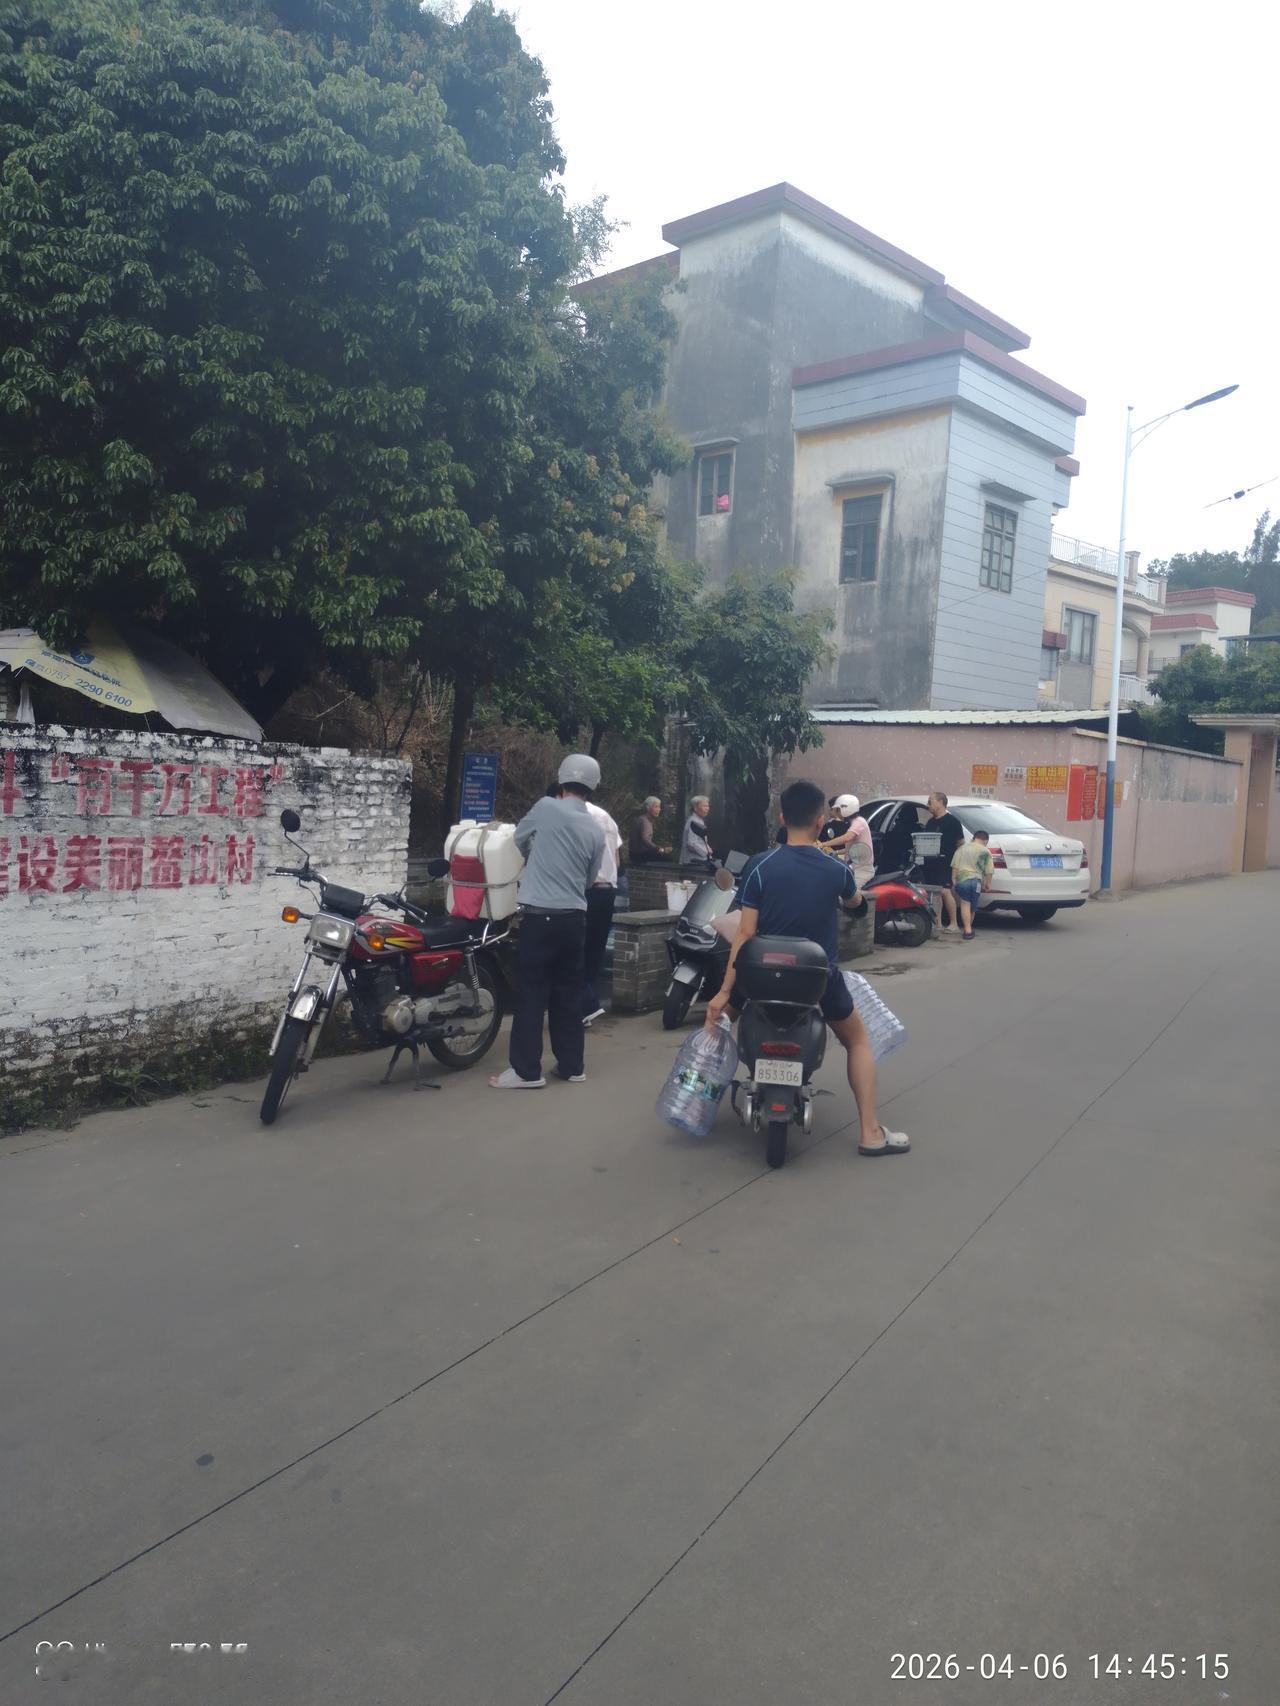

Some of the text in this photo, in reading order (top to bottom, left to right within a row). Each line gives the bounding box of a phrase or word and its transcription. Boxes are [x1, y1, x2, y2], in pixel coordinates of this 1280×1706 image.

[74, 678, 104, 696] 2290
[105, 691, 133, 708] 6100
[758, 1069, 800, 1082] 853306
